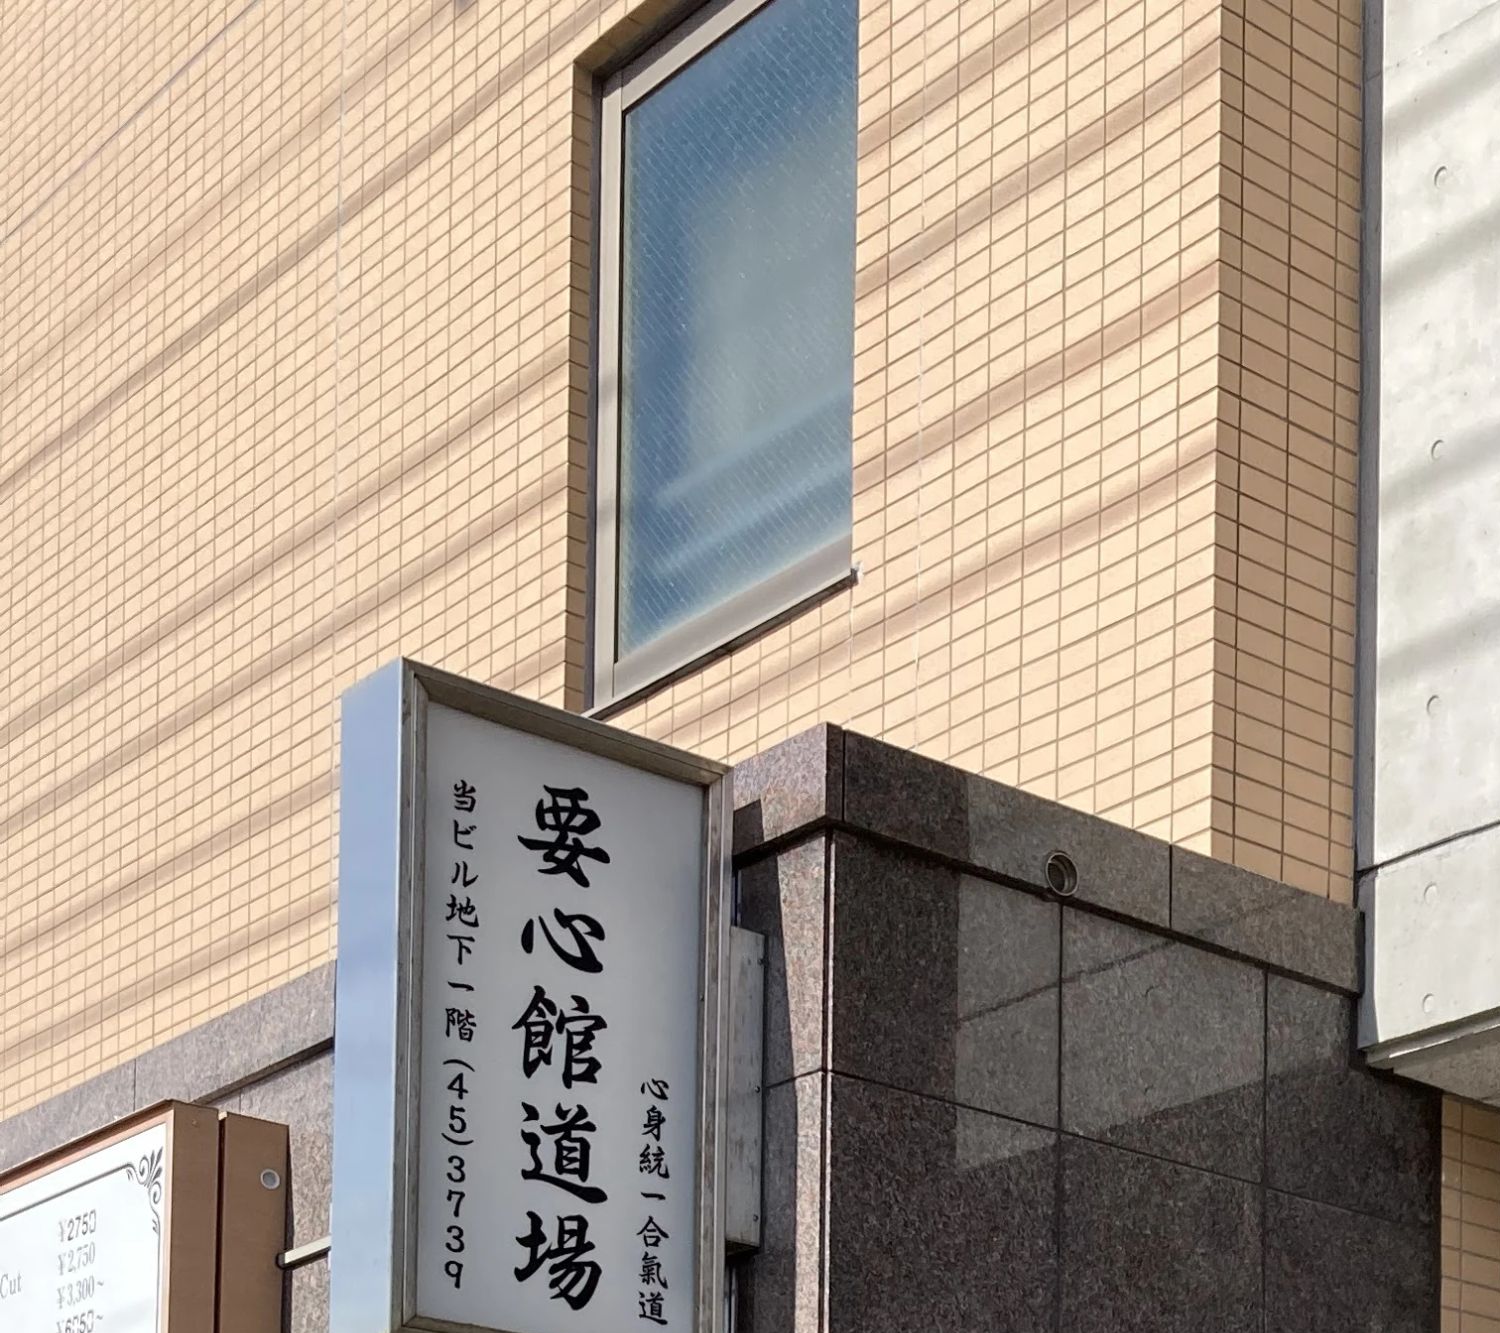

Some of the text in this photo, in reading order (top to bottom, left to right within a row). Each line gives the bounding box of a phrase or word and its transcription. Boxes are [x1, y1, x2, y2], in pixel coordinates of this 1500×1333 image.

[510, 784, 611, 1313] 要心館道場
[635, 1076, 671, 1327] 心身統一合氣道
